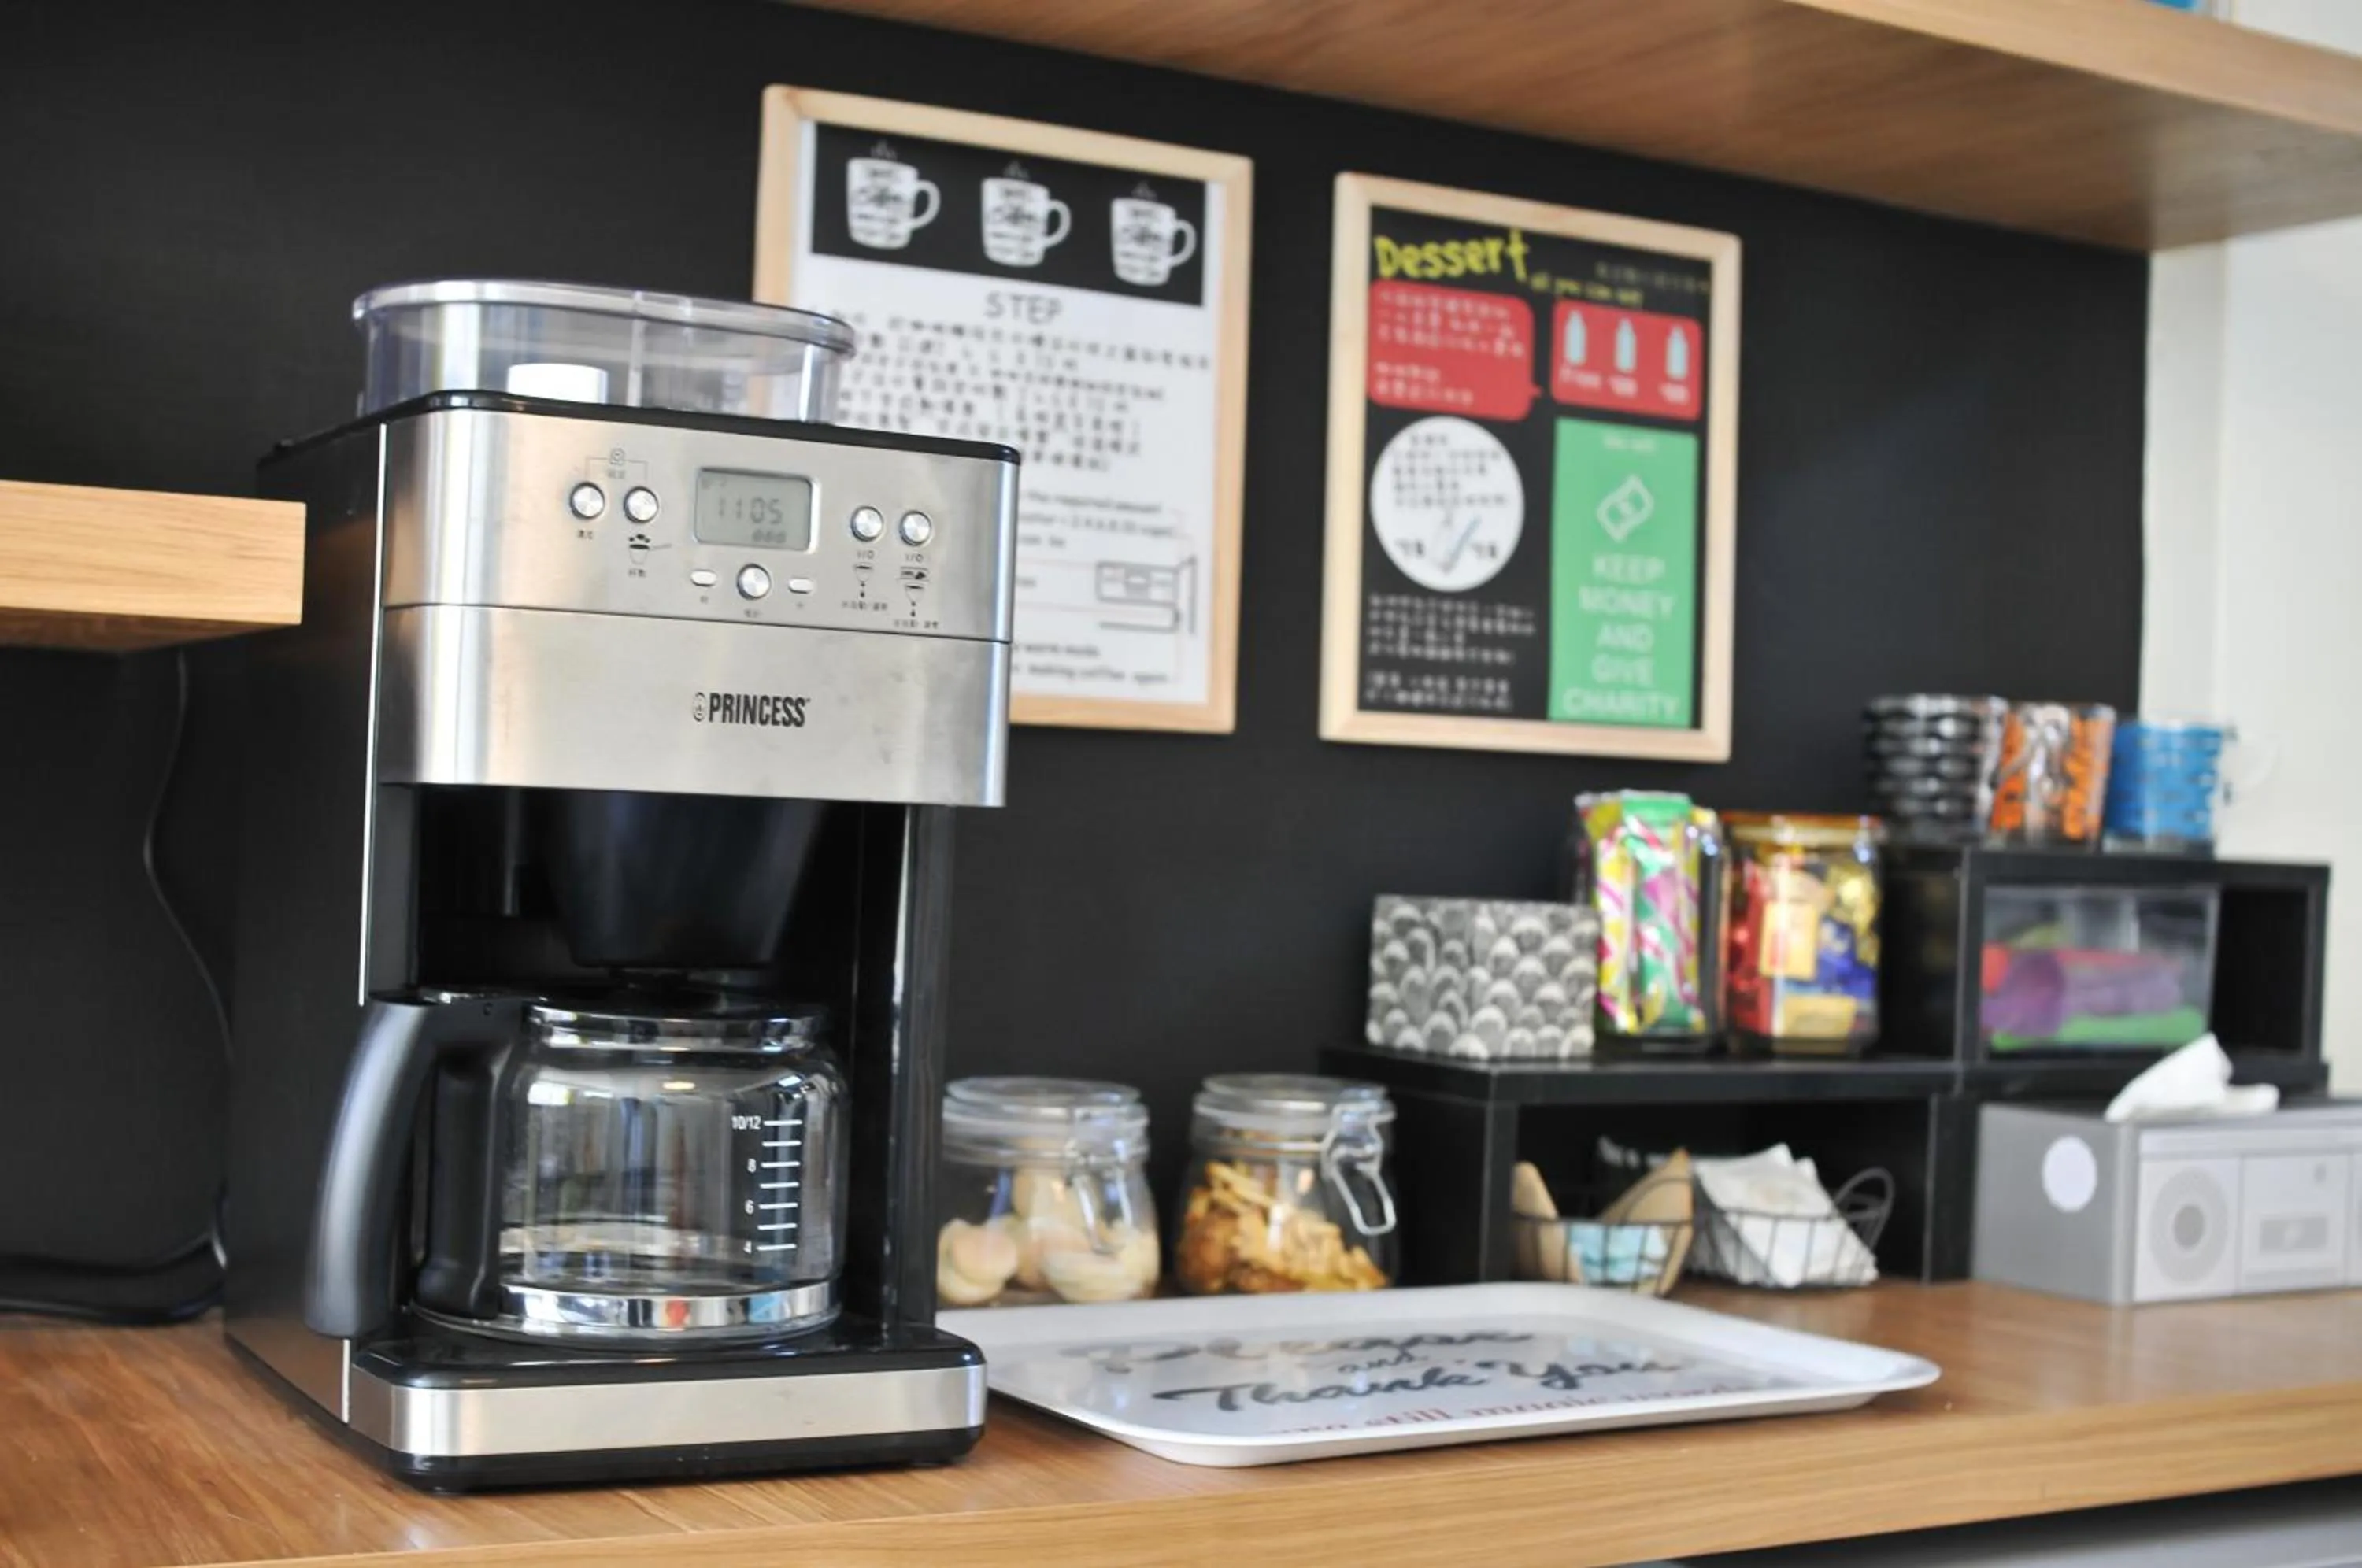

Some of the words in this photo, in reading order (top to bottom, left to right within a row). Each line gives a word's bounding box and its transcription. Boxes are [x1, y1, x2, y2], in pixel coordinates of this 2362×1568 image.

[1374, 228, 1528, 282] Dessert
[984, 290, 1063, 325] STEP
[709, 692, 806, 727] PRINCESS
[731, 1115, 761, 1130] 10/12
[747, 1158, 757, 1173] 8
[745, 1199, 754, 1215] 6
[743, 1241, 753, 1255] 4
